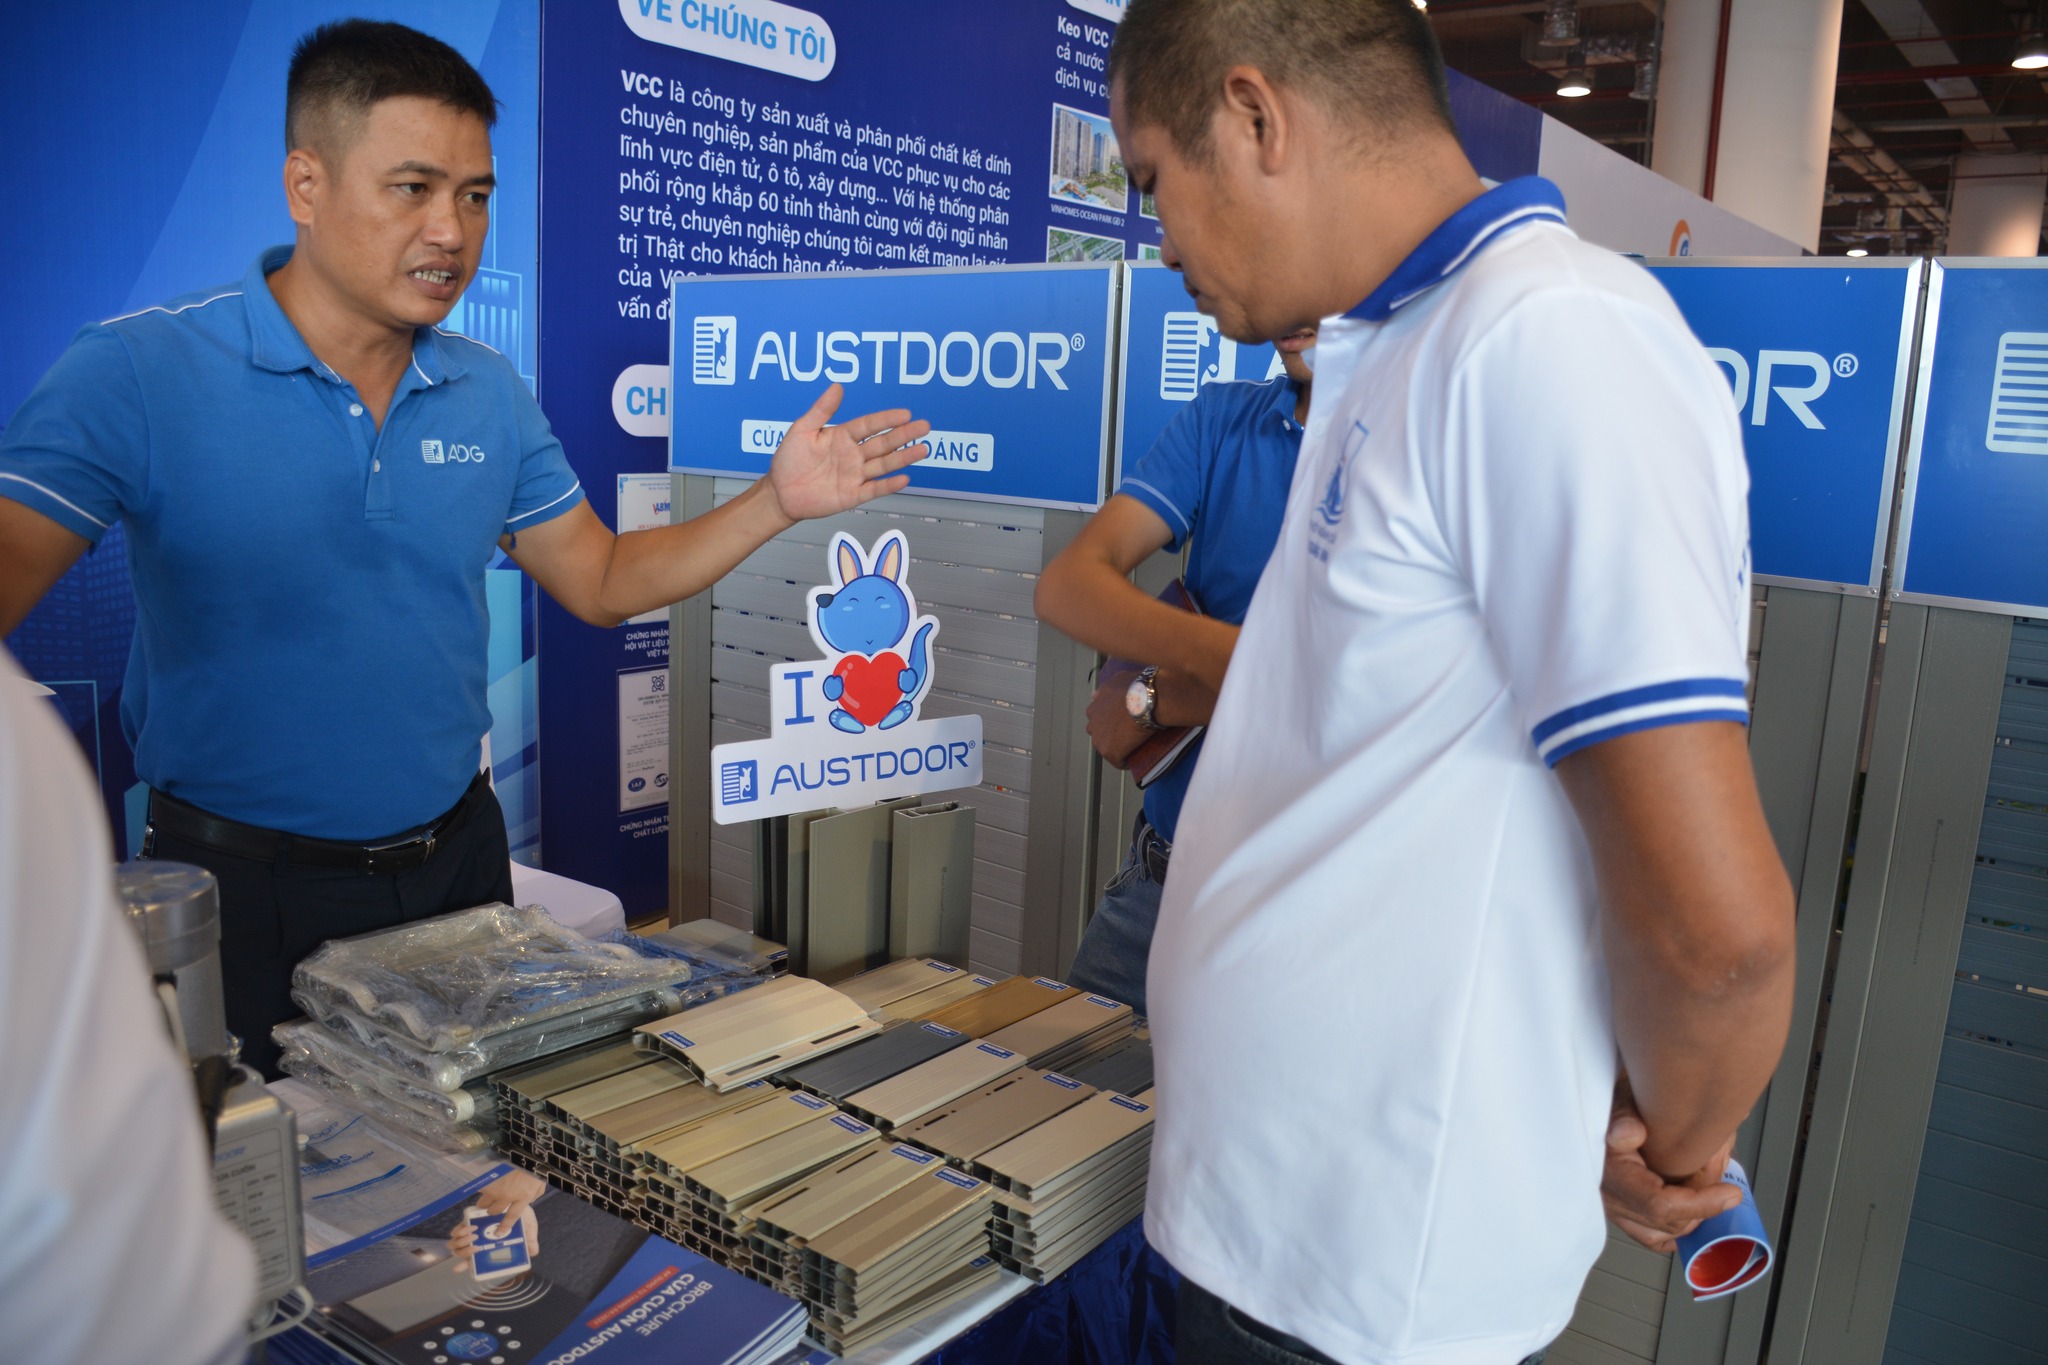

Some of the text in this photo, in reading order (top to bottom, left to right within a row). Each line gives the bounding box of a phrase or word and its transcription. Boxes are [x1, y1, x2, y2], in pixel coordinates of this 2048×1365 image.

[681, 0, 777, 50] CHÚNG
[785, 25, 826, 63] TÔI
[1057, 15, 1109, 48] Keo VCC
[1056, 42, 1104, 72] cả nước
[1055, 67, 1080, 89] dịch
[1083, 78, 1096, 97] vụ
[621, 69, 1012, 175] VCC là công ty sản xuất và phân phối chất kết dính
[620, 104, 1010, 200] chuyên nghiệp, sản phẩm của VCC phục vụ cho các
[620, 134, 653, 160] lĩnh
[660, 147, 692, 170] vực
[699, 149, 735, 177] điện
[741, 158, 762, 183] tử,
[768, 163, 778, 182] ô
[784, 167, 803, 190] tô,
[809, 172, 834, 197] xây
[893, 187, 914, 208] Với
[919, 191, 935, 215] hệ
[939, 197, 975, 223] thống
[979, 205, 1009, 226] phân
[620, 169, 1008, 250] phối rộng khắp 60 tỉnh thành cùng với đội ngũ nhân
[1051, 203, 1080, 218] VINHOMES
[1080, 210, 1099, 222] OCEAN
[618, 234, 637, 258] trị
[644, 235, 685, 263] Thật
[691, 242, 723, 264] cho
[729, 245, 777, 271] khách
[783, 252, 821, 273] hàng
[619, 205, 643, 227] sự
[648, 204, 676, 231] trẻ,
[681, 209, 742, 238] chuyên
[747, 221, 800, 249] nghiệp
[804, 228, 850, 256] chúng
[854, 236, 872, 255] tôi
[876, 242, 905, 260] cam
[909, 243, 929, 264] kết
[618, 263, 652, 287] của
[618, 295, 650, 319] vấn
[447, 444, 484, 463] ADG
[783, 670, 815, 725] I
[661, 1273, 695, 1296] CỬA
[635, 1280, 713, 1336] BROCHURE
